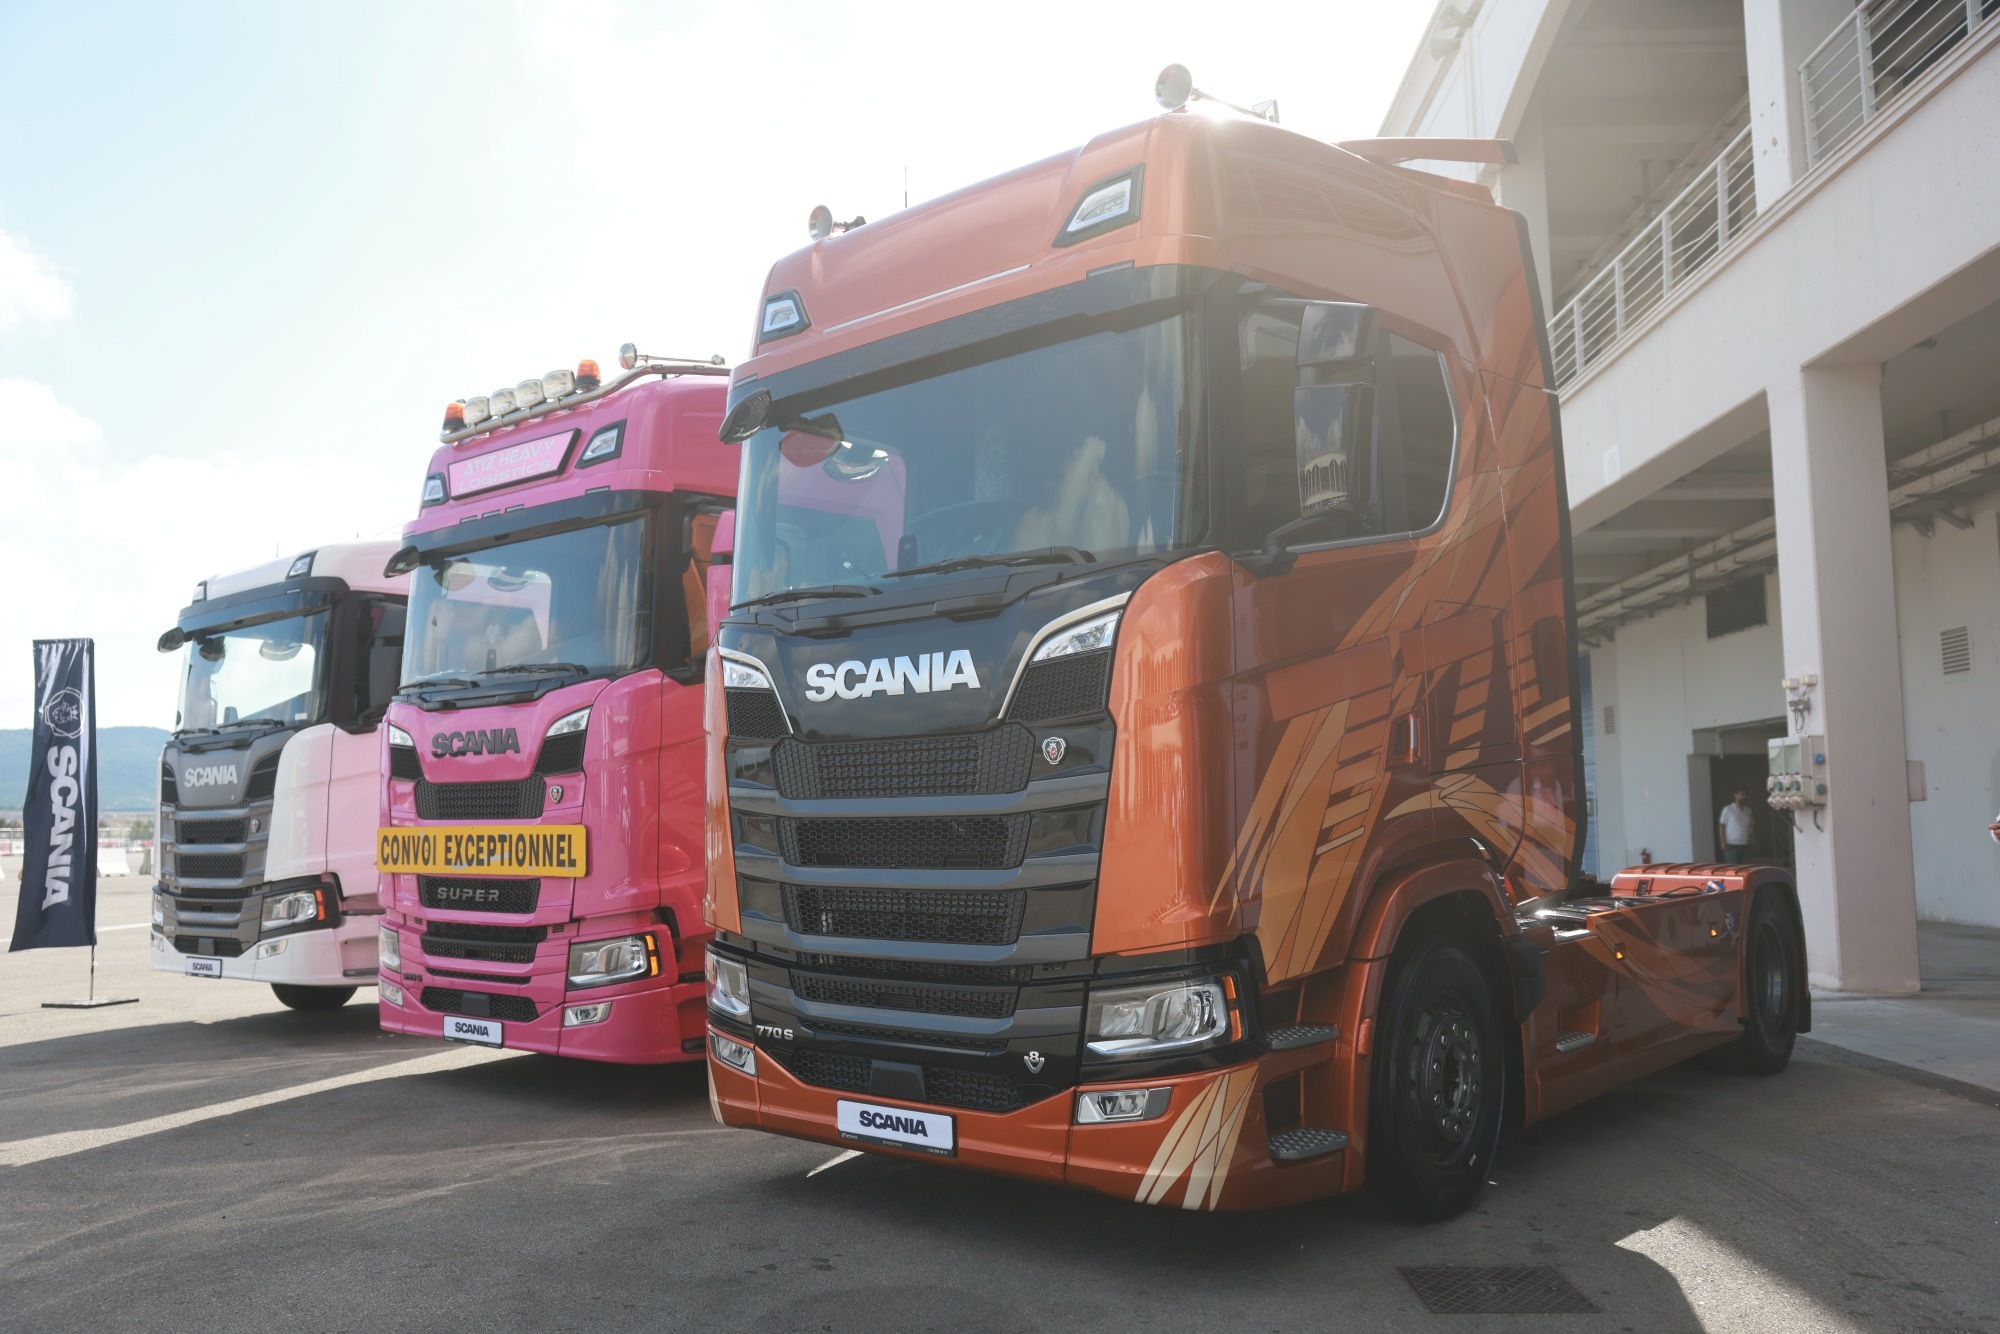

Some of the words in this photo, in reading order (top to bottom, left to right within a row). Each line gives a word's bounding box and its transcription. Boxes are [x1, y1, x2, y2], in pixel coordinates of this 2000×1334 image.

[499, 439, 556, 468] HEAVY
[805, 649, 981, 702] SCANIA
[431, 728, 520, 759] SCANIA
[184, 765, 238, 788] SCANIA
[42, 745, 79, 911] SCANIA
[380, 834, 437, 866] CONVOI
[444, 833, 577, 868] EXCEPTIONNEL
[436, 887, 500, 902] SUPER
[192, 962, 213, 972] SCANIA
[454, 1022, 490, 1037] SCANIA
[859, 1110, 928, 1137] SCANIA
